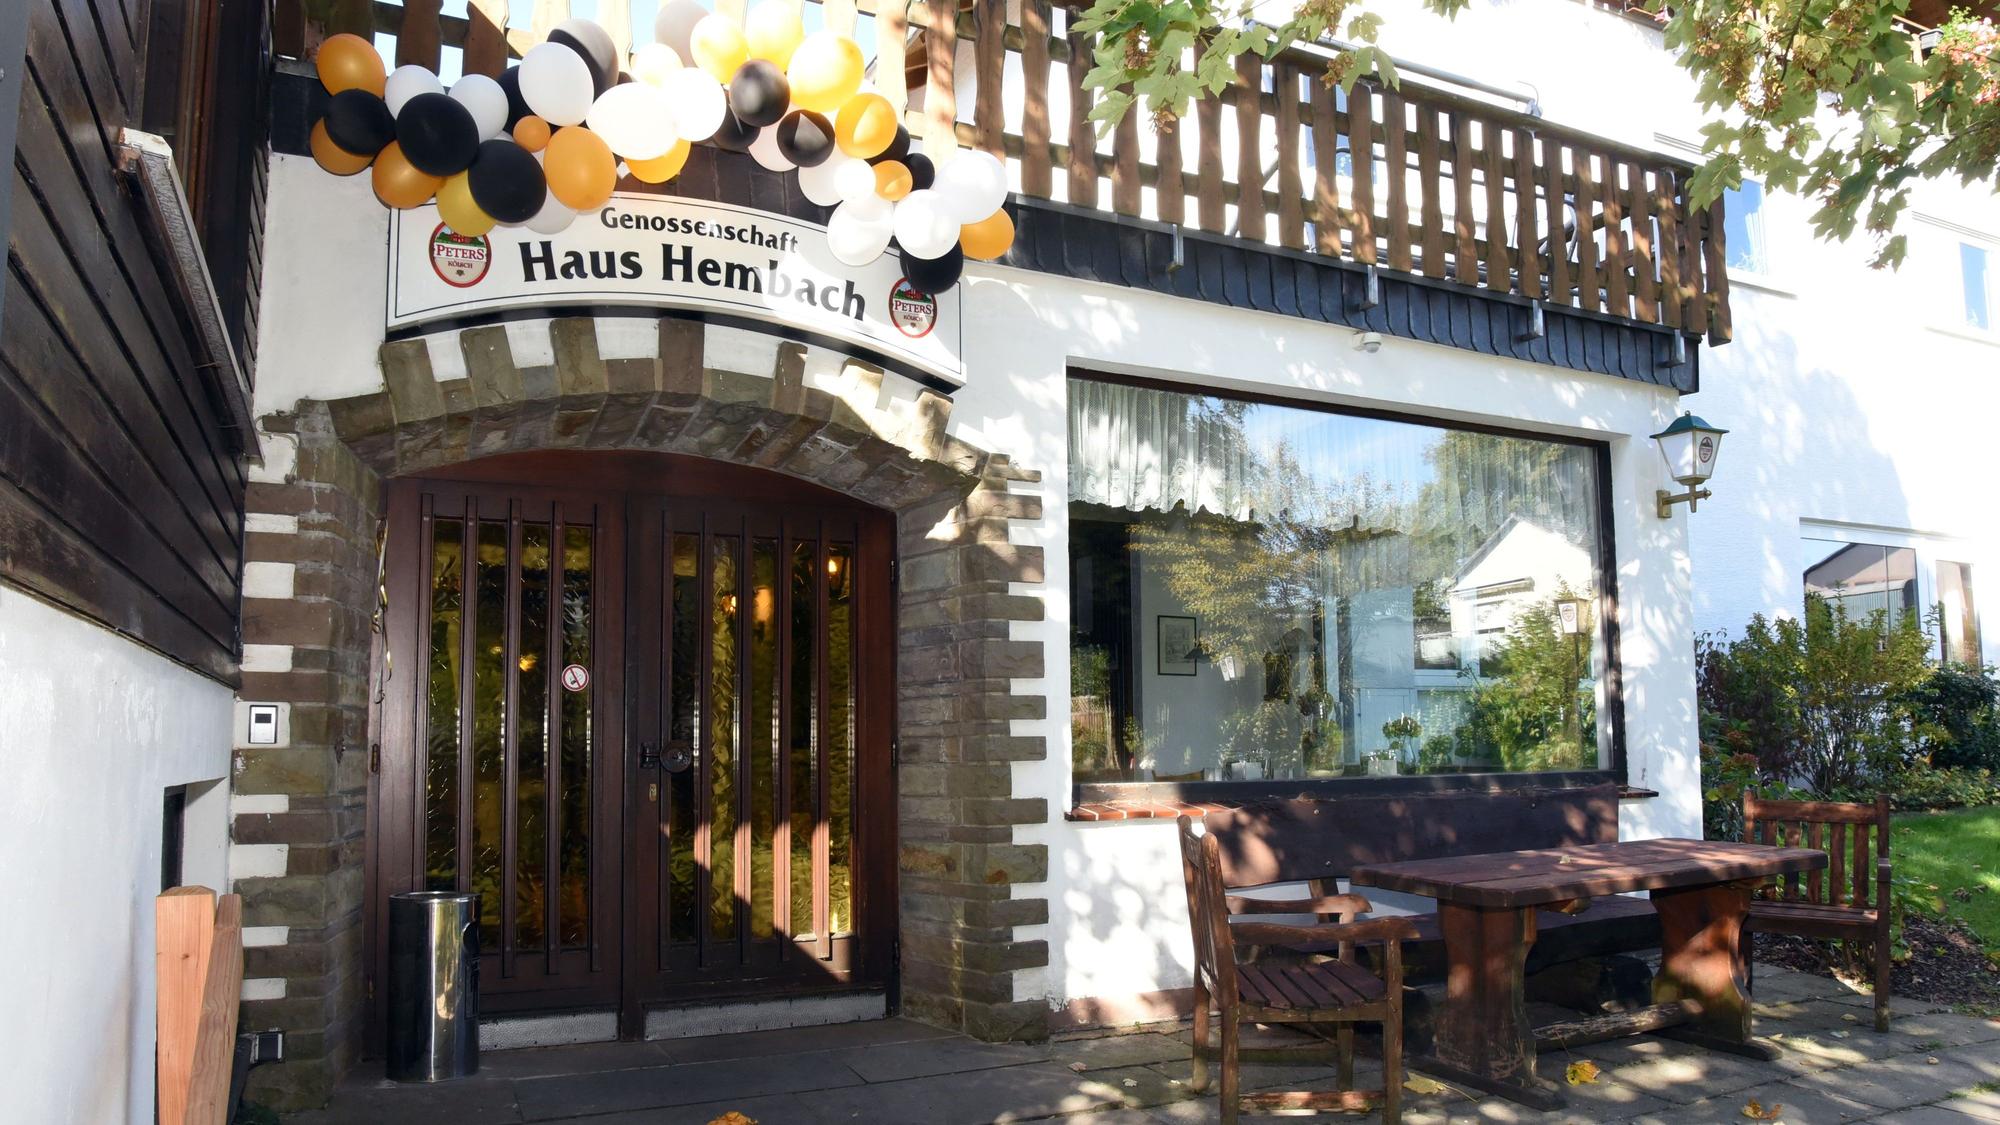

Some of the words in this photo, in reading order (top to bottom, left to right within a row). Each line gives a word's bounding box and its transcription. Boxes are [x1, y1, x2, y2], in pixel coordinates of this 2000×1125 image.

[600, 206, 797, 254] Genossenschaft
[436, 244, 485, 260] PETERS
[518, 240, 643, 283] Haus
[662, 243, 866, 322] Hembach
[894, 300, 933, 314] PETERS
